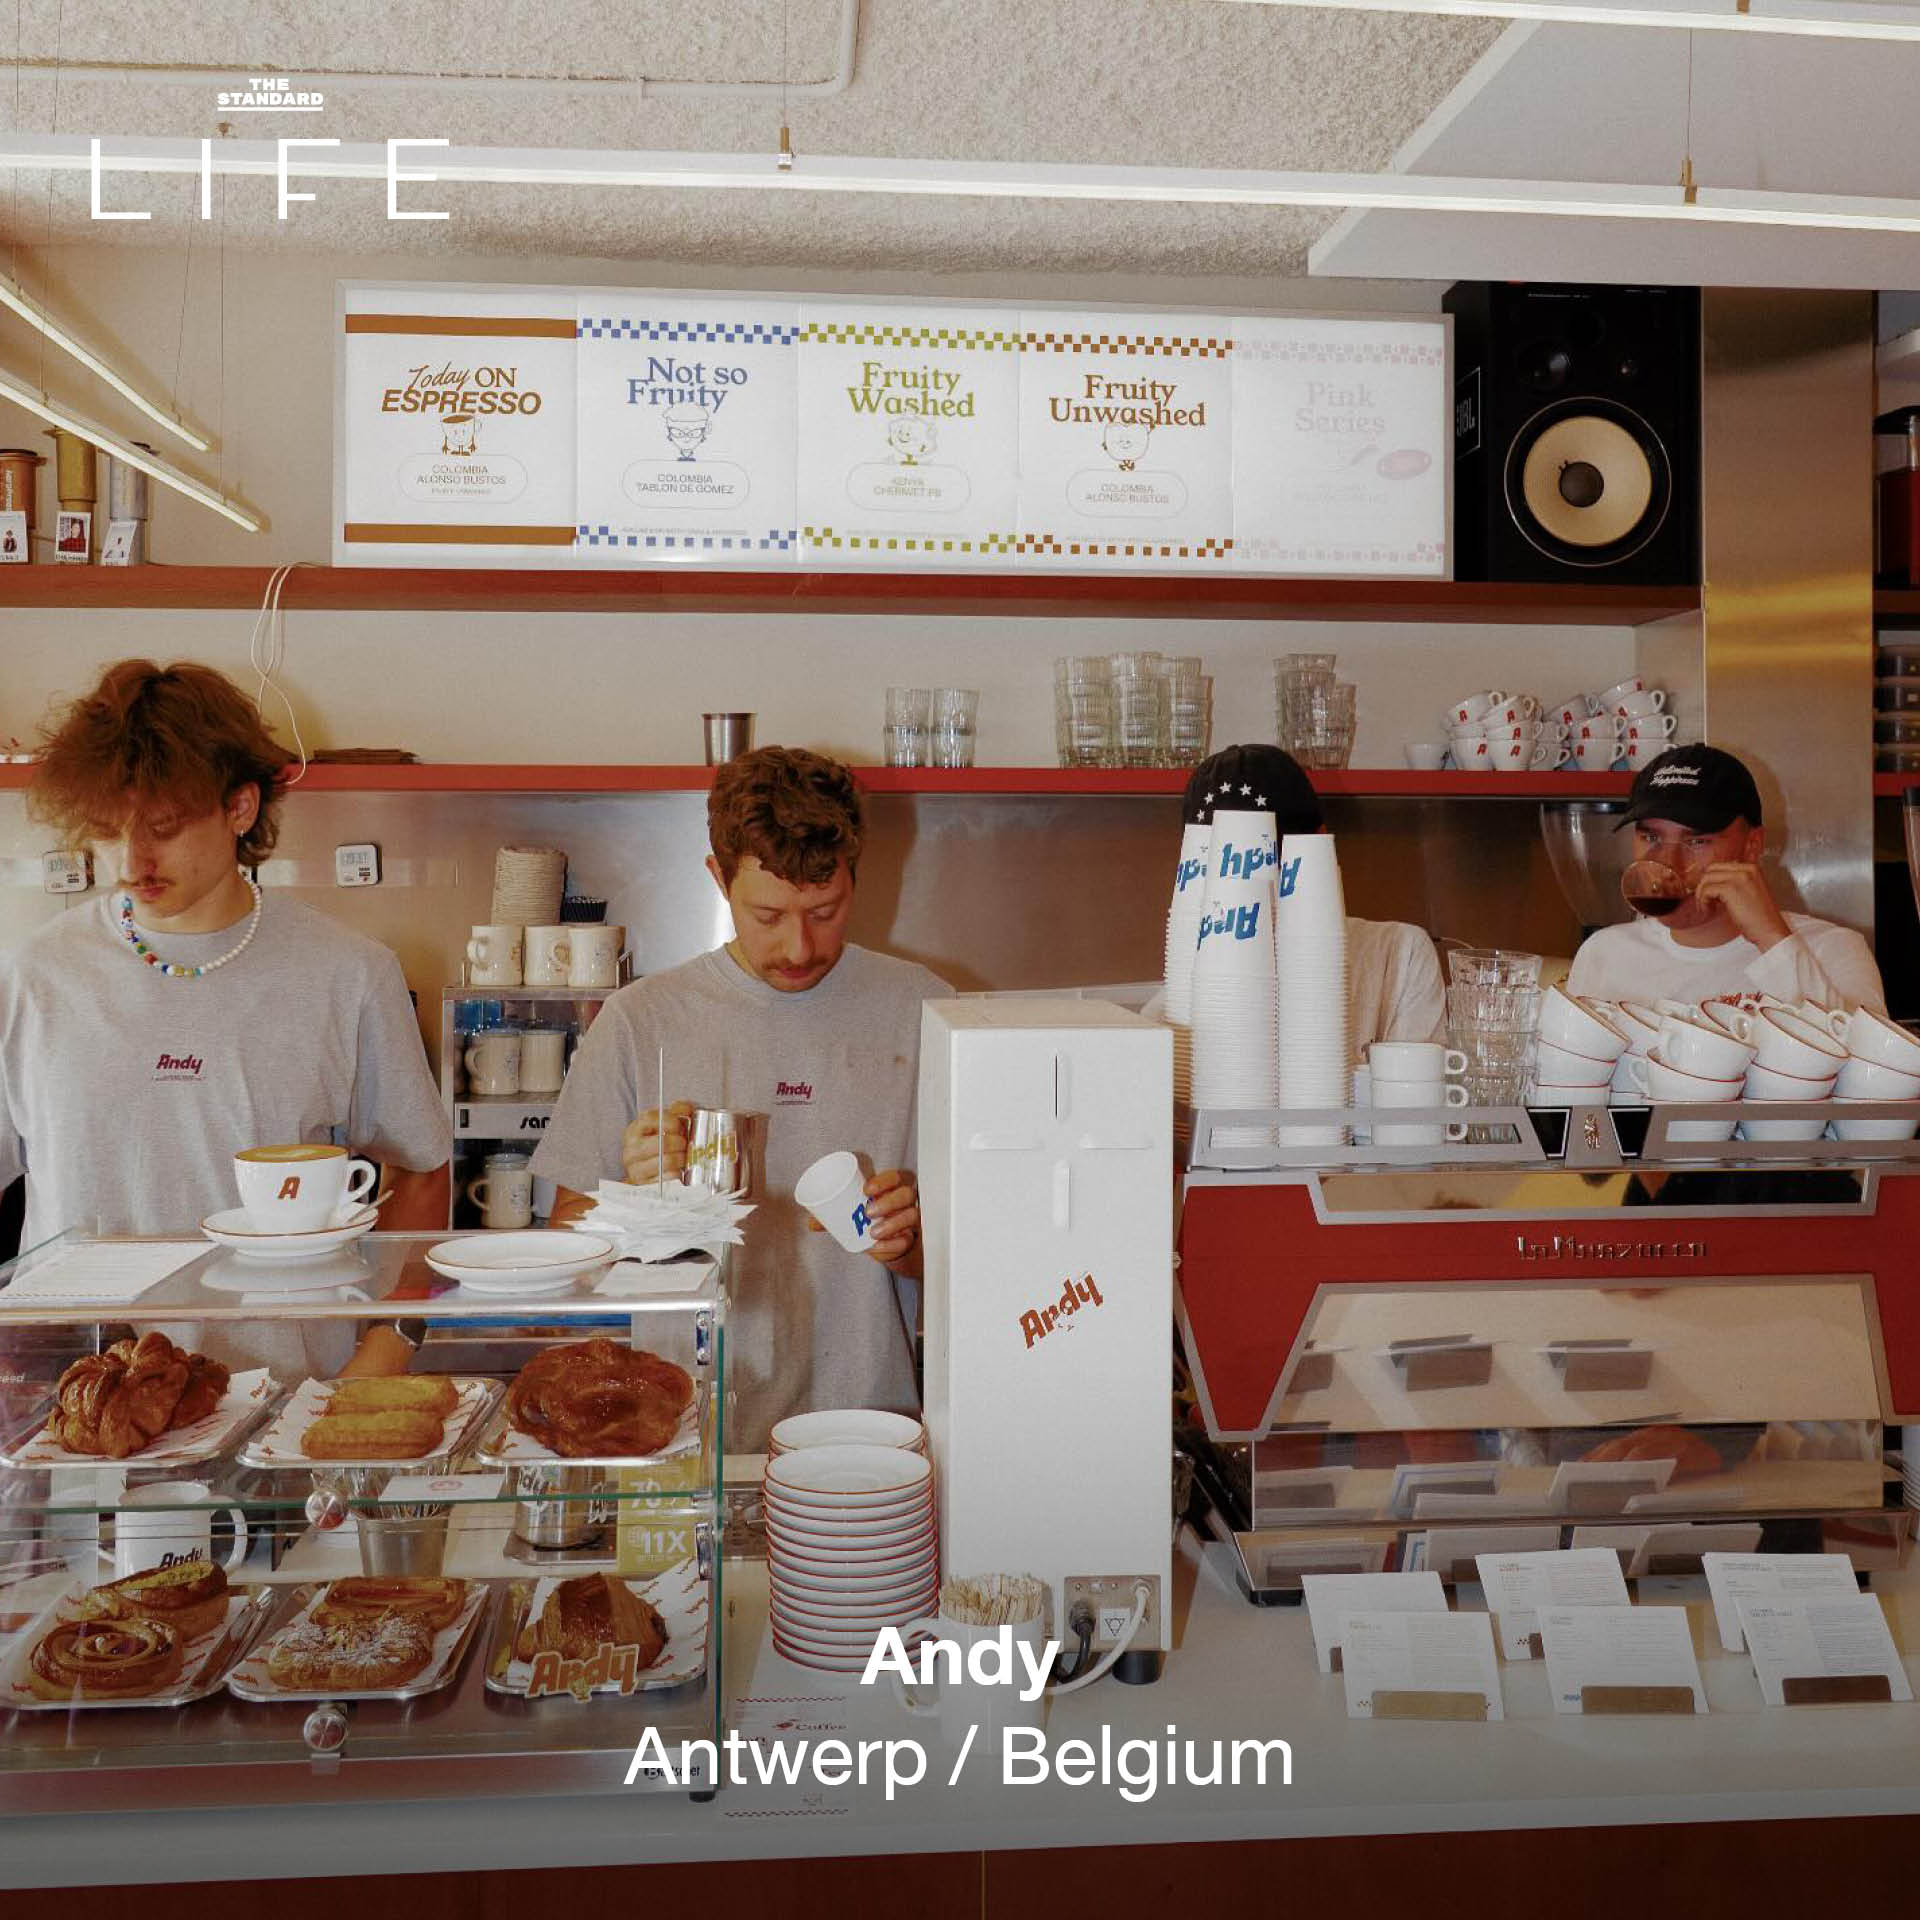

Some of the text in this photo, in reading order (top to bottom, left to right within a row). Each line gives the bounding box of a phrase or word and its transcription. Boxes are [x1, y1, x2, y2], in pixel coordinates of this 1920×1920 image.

[408, 361, 518, 392] Today ON
[647, 356, 748, 385] Not so
[862, 361, 961, 396] Fruity
[381, 389, 542, 415] ESPRESSO
[626, 378, 728, 414] Fruity
[846, 387, 975, 417] Washed
[1084, 374, 1178, 407] Fruity
[1305, 381, 1377, 408] Pink
[1048, 397, 1206, 427] Unwashed
[1295, 407, 1385, 433] Series
[416, 475, 461, 486] ALONSO
[431, 464, 489, 475] COLOMBIA
[657, 473, 713, 484] COLOMBIA
[680, 484, 694, 494] DE
[696, 485, 736, 495] GOMEZ
[156, 1054, 203, 1075] Andy
[776, 1081, 813, 1099] Andy
[520, 1116, 551, 1129] sar
[278, 1176, 301, 1199] A
[1019, 1273, 1104, 1349] Andy
[525, 1642, 640, 1699] Andy
